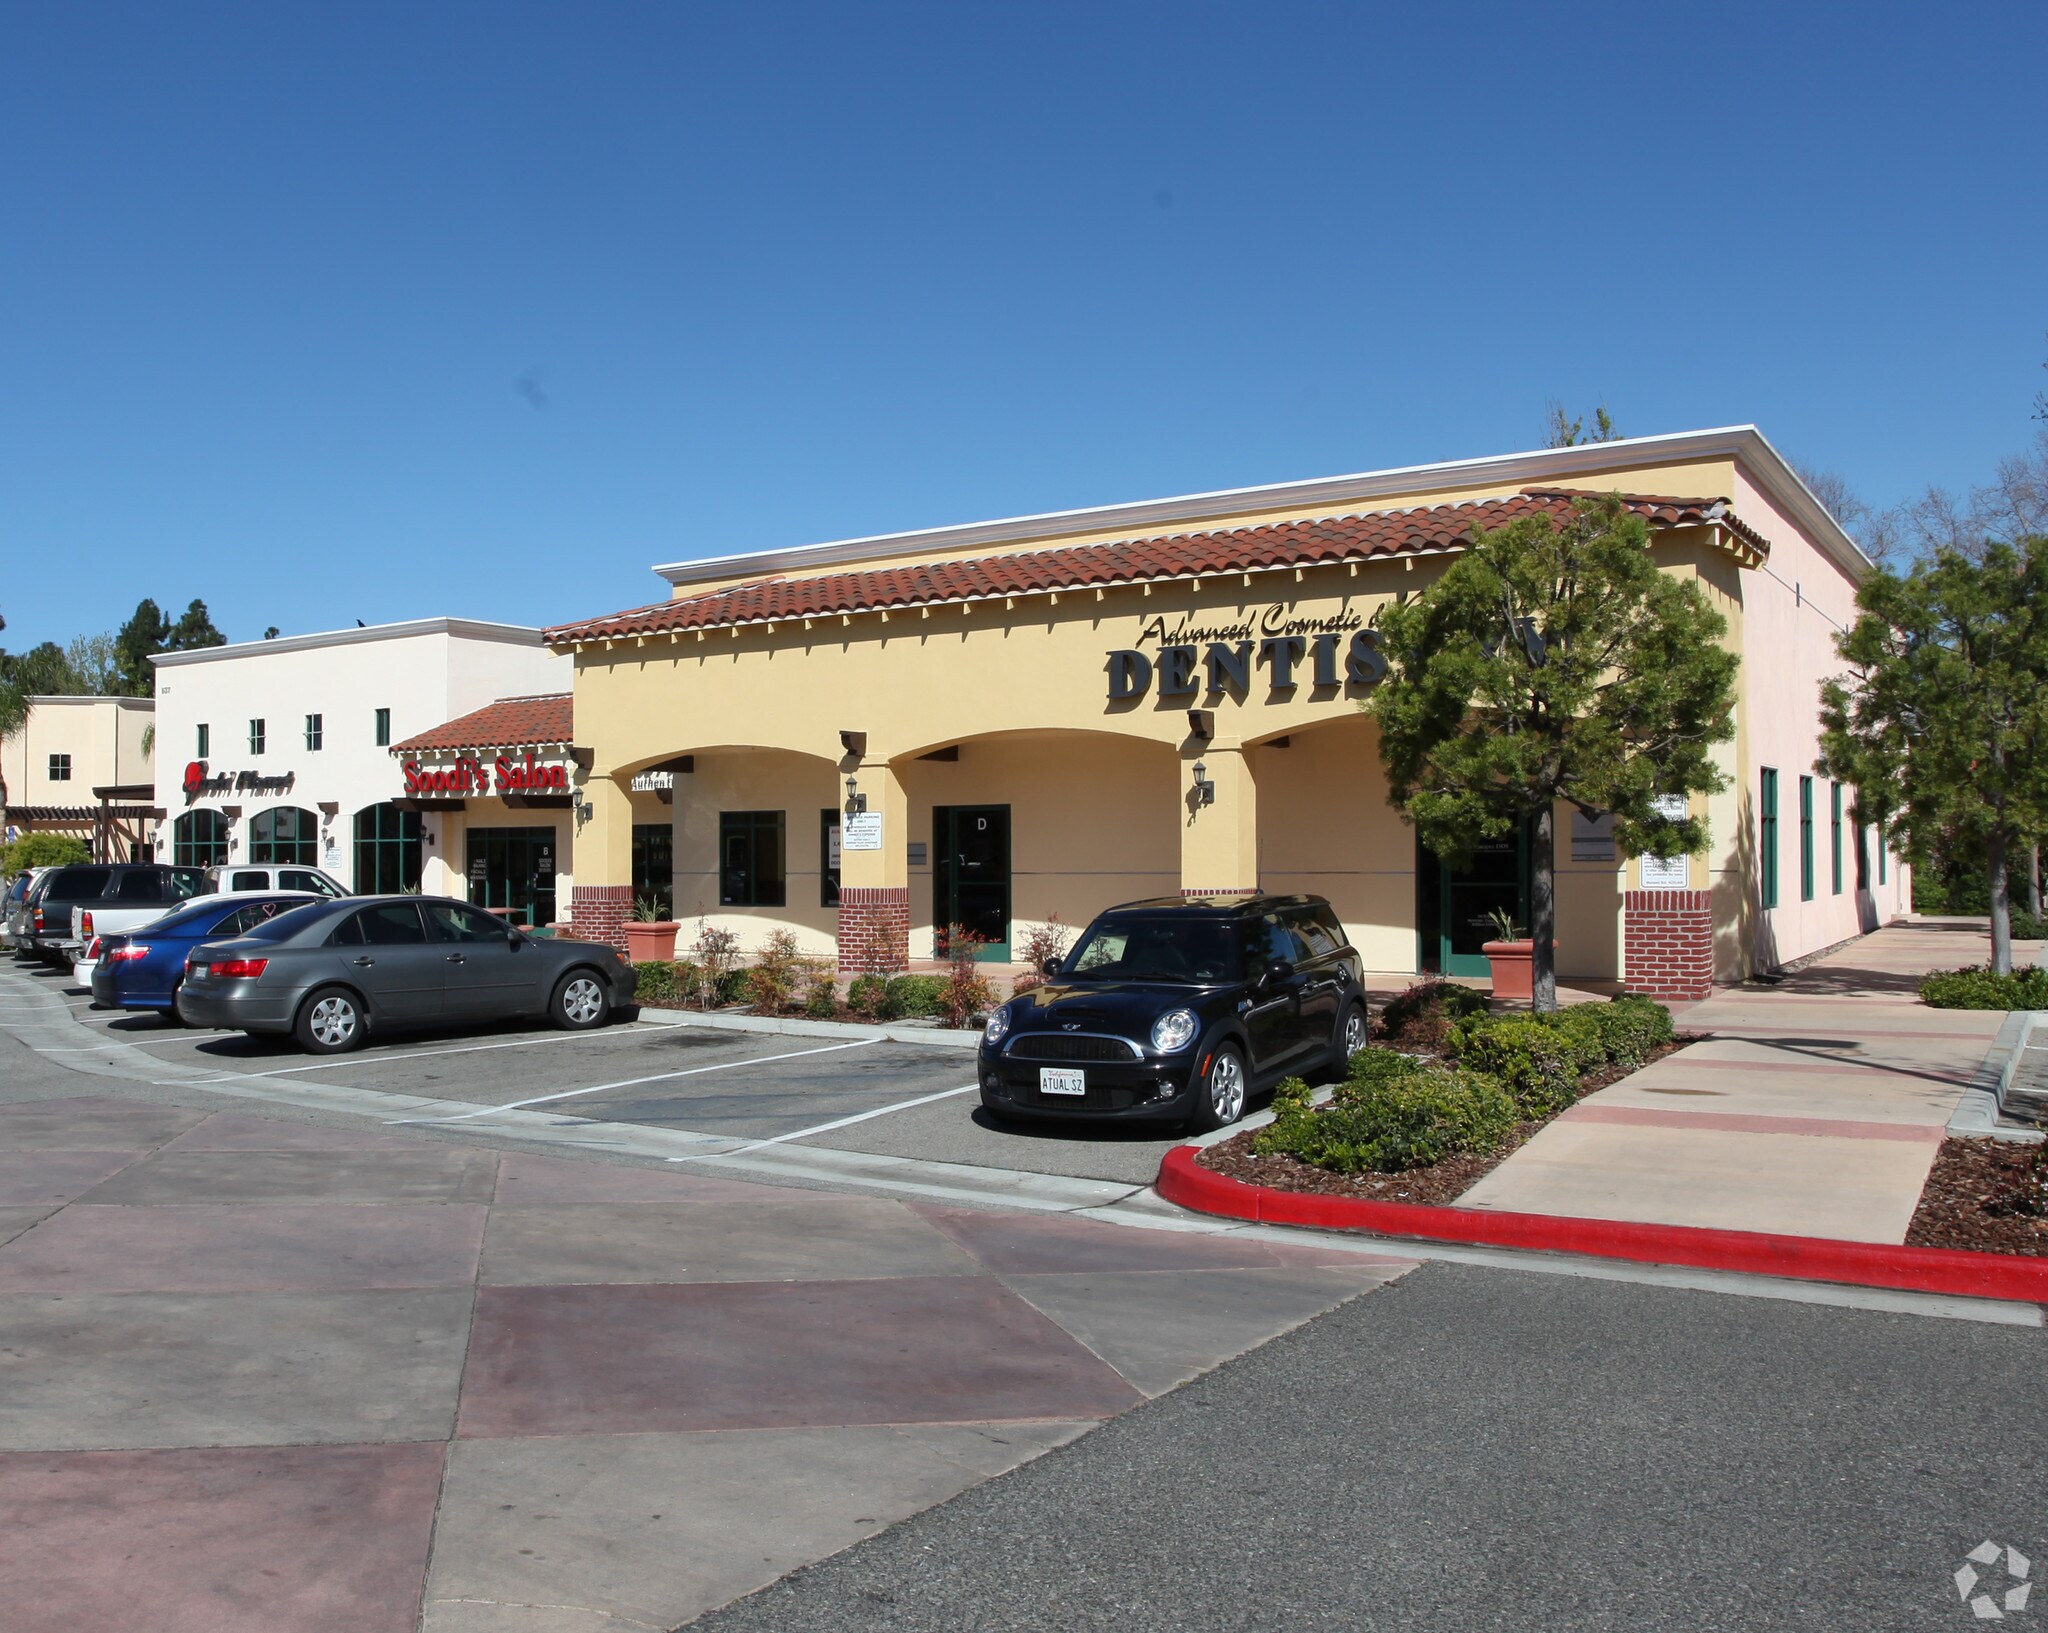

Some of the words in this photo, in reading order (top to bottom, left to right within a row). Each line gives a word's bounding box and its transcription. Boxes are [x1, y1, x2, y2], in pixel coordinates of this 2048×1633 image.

[1135, 614, 1256, 650] Advanced
[1260, 601, 1363, 636] Cosmetic
[403, 756, 491, 794] Soodi's
[494, 752, 566, 790] Salon
[977, 817, 987, 831] D
[1042, 1077, 1070, 1091] ATUAL
[1071, 1078, 1083, 1092] SZ
